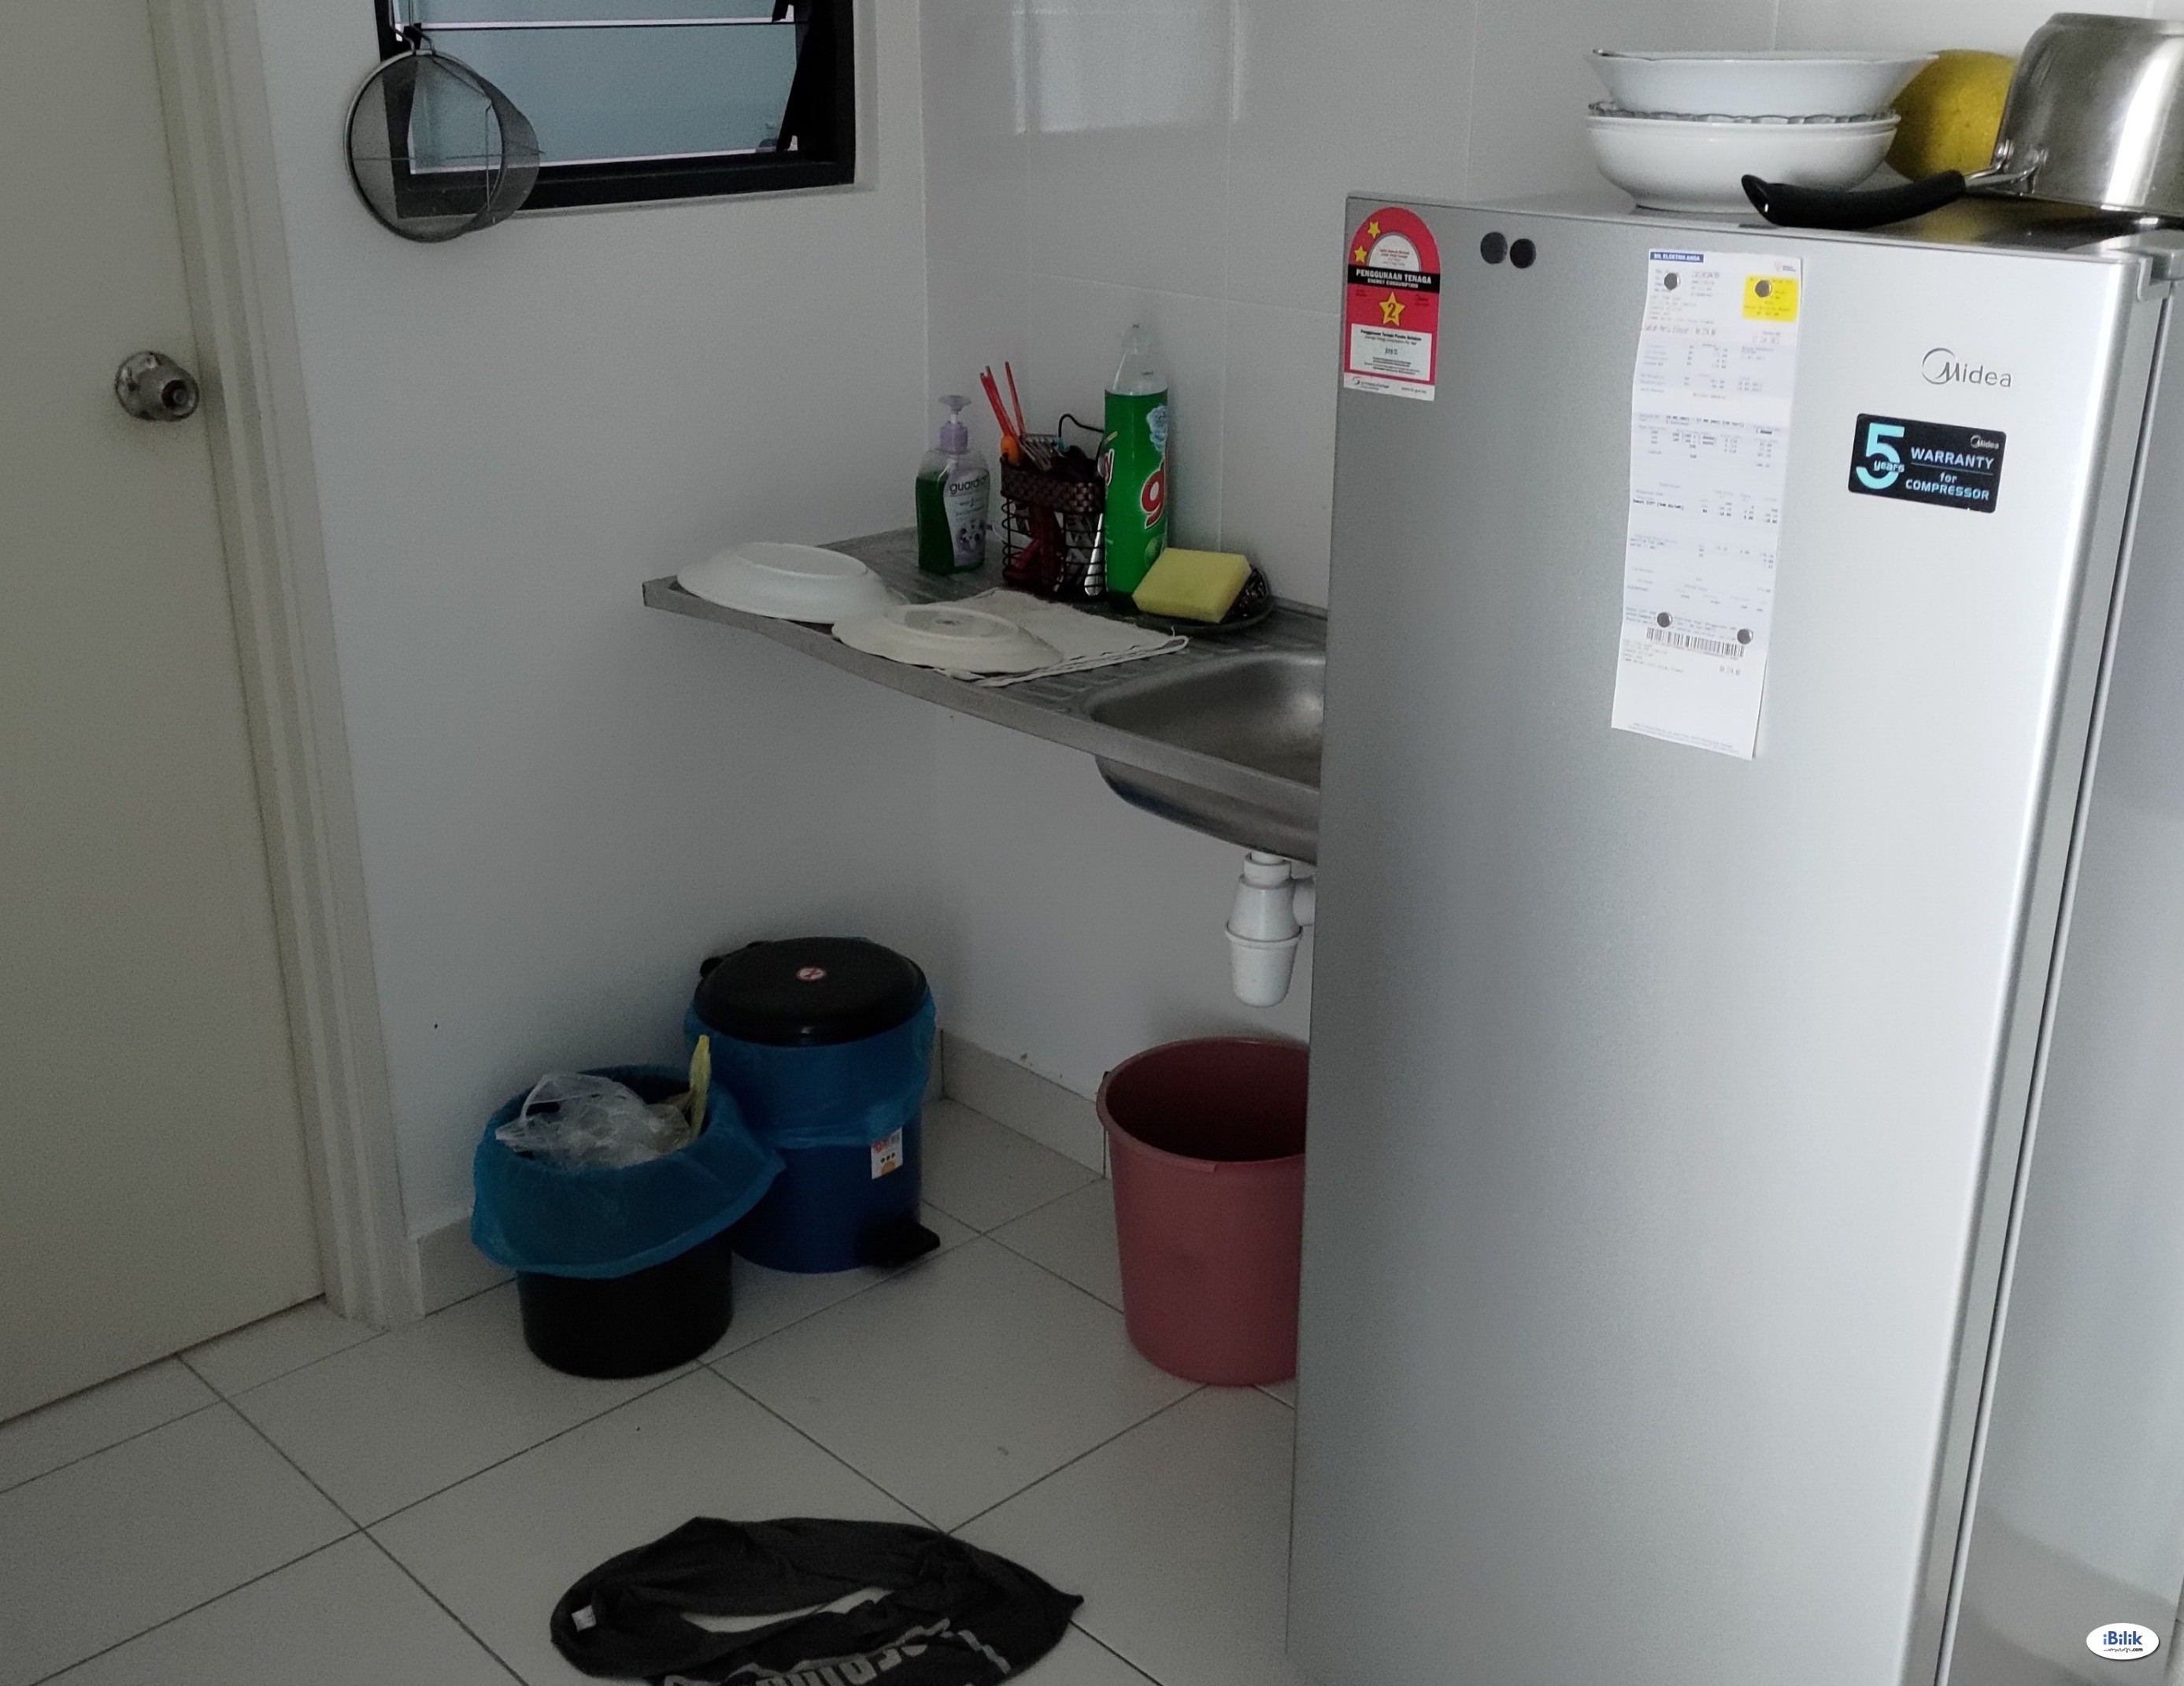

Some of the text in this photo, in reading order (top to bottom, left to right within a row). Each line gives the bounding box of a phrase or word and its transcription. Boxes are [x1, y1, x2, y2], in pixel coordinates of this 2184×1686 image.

[1356, 268, 1431, 284] PENGGUNAAN TENAGA
[1388, 302, 1396, 319] 2
[1922, 347, 2012, 387] Midea
[1970, 434, 2000, 449] Midea
[1856, 423, 1905, 489] 5
[1911, 446, 1994, 470] WARRANTY
[1873, 459, 1905, 473] years
[1939, 471, 1957, 483] for
[1905, 479, 1990, 501] COMPRESSOR
